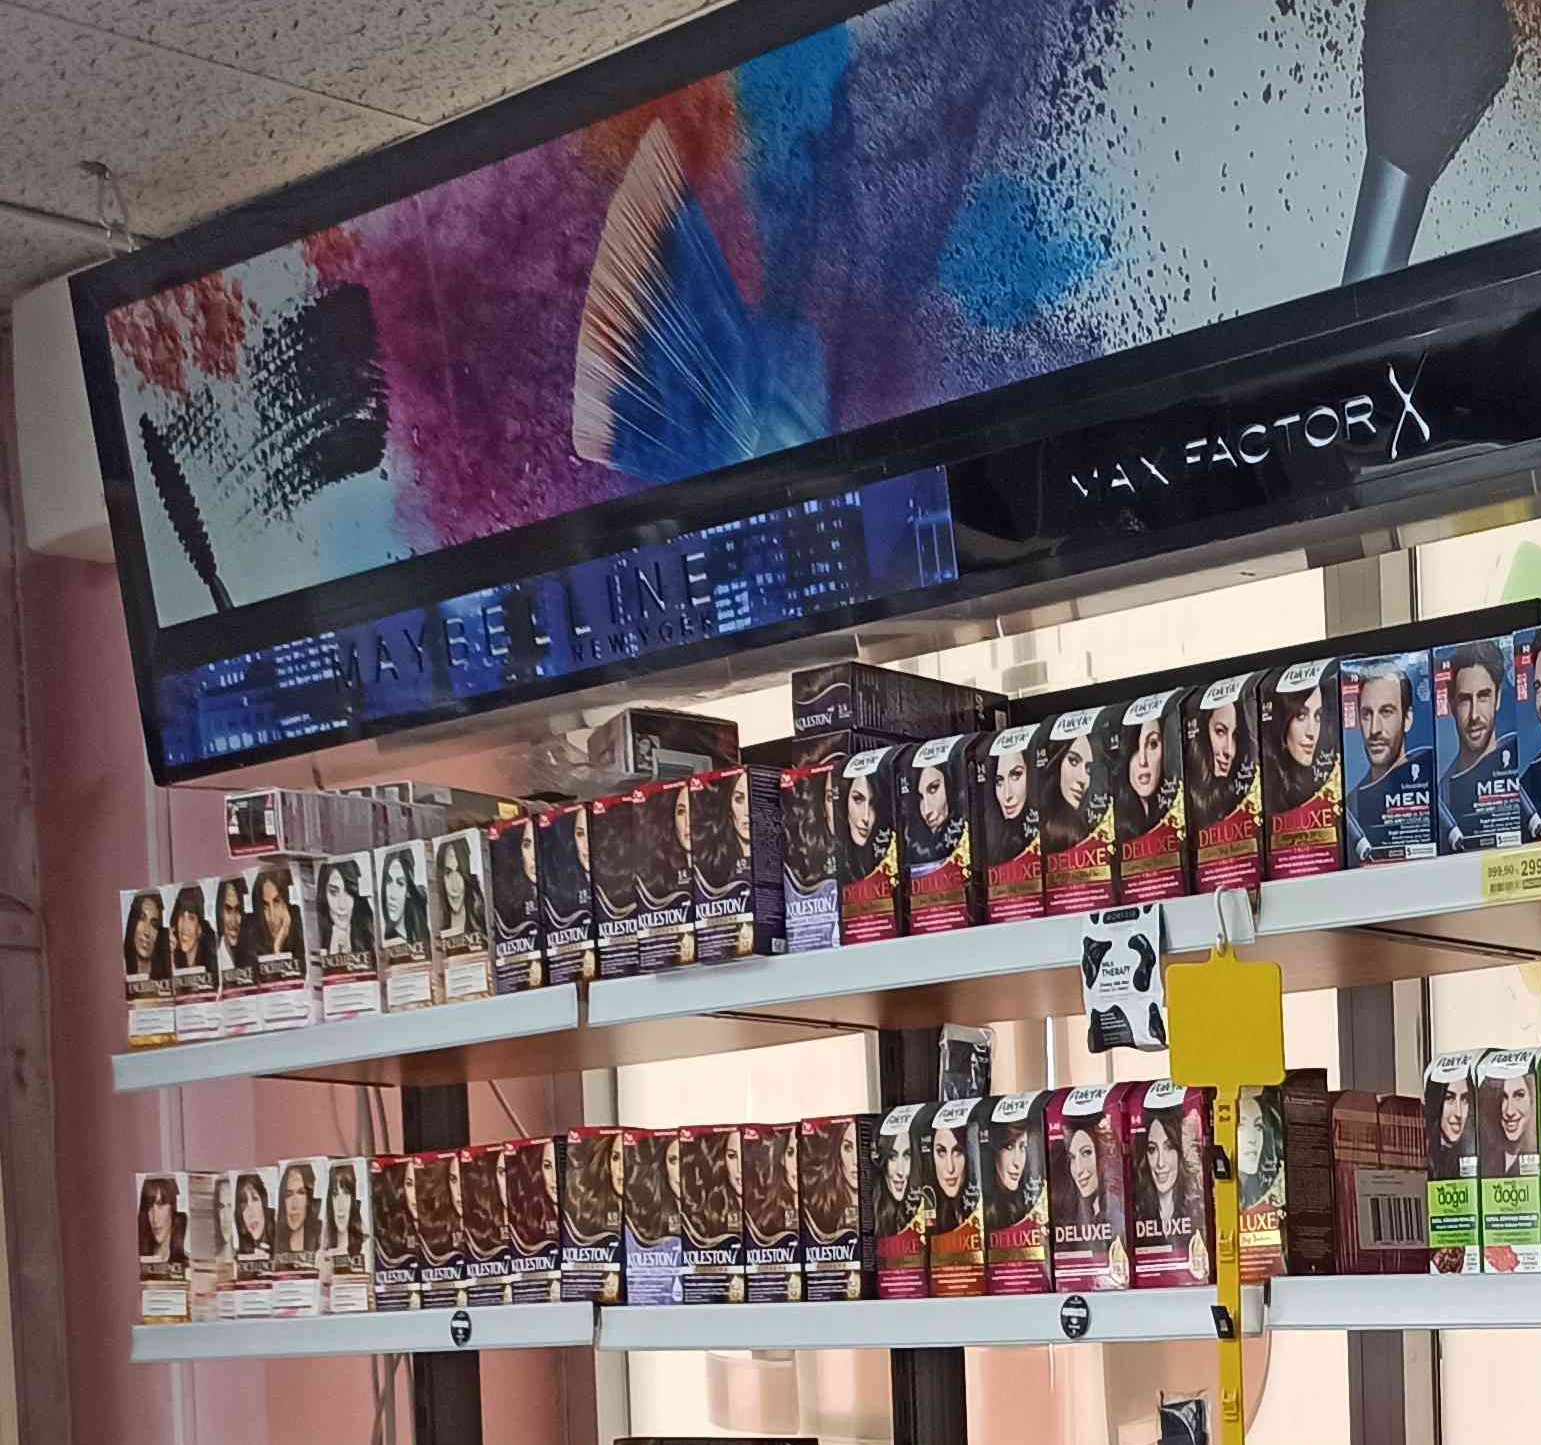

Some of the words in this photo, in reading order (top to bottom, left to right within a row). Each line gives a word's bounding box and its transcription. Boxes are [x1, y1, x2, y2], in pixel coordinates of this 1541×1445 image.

[1185, 395, 1376, 469] FACTOR
[1477, 777, 1520, 796] MEN
[1385, 790, 1430, 808] MEN
[1054, 1222, 1112, 1243] DELUXE
